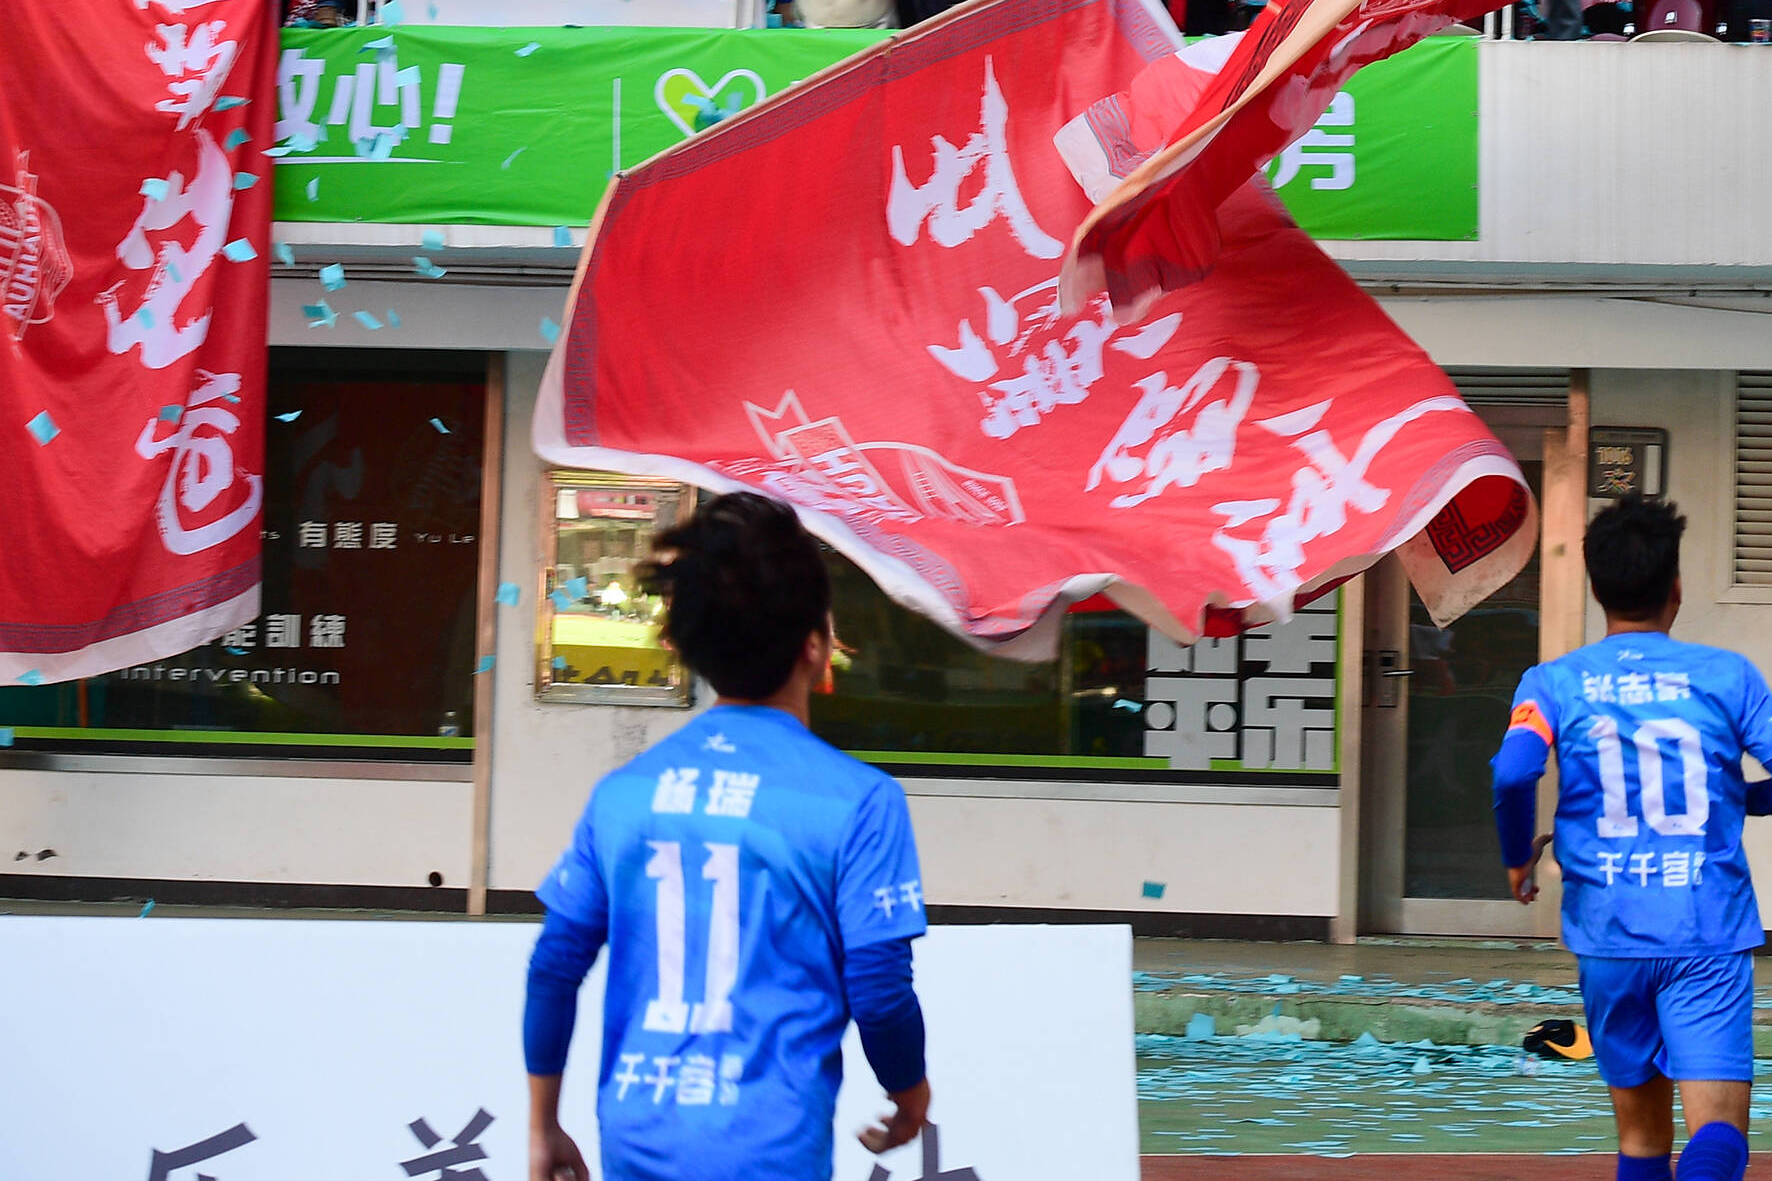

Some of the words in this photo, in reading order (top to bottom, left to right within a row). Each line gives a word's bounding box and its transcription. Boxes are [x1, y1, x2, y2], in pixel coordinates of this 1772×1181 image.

[299, 521, 398, 549] 有態度
[1588, 715, 1710, 838] 10
[643, 841, 739, 1034] 11
